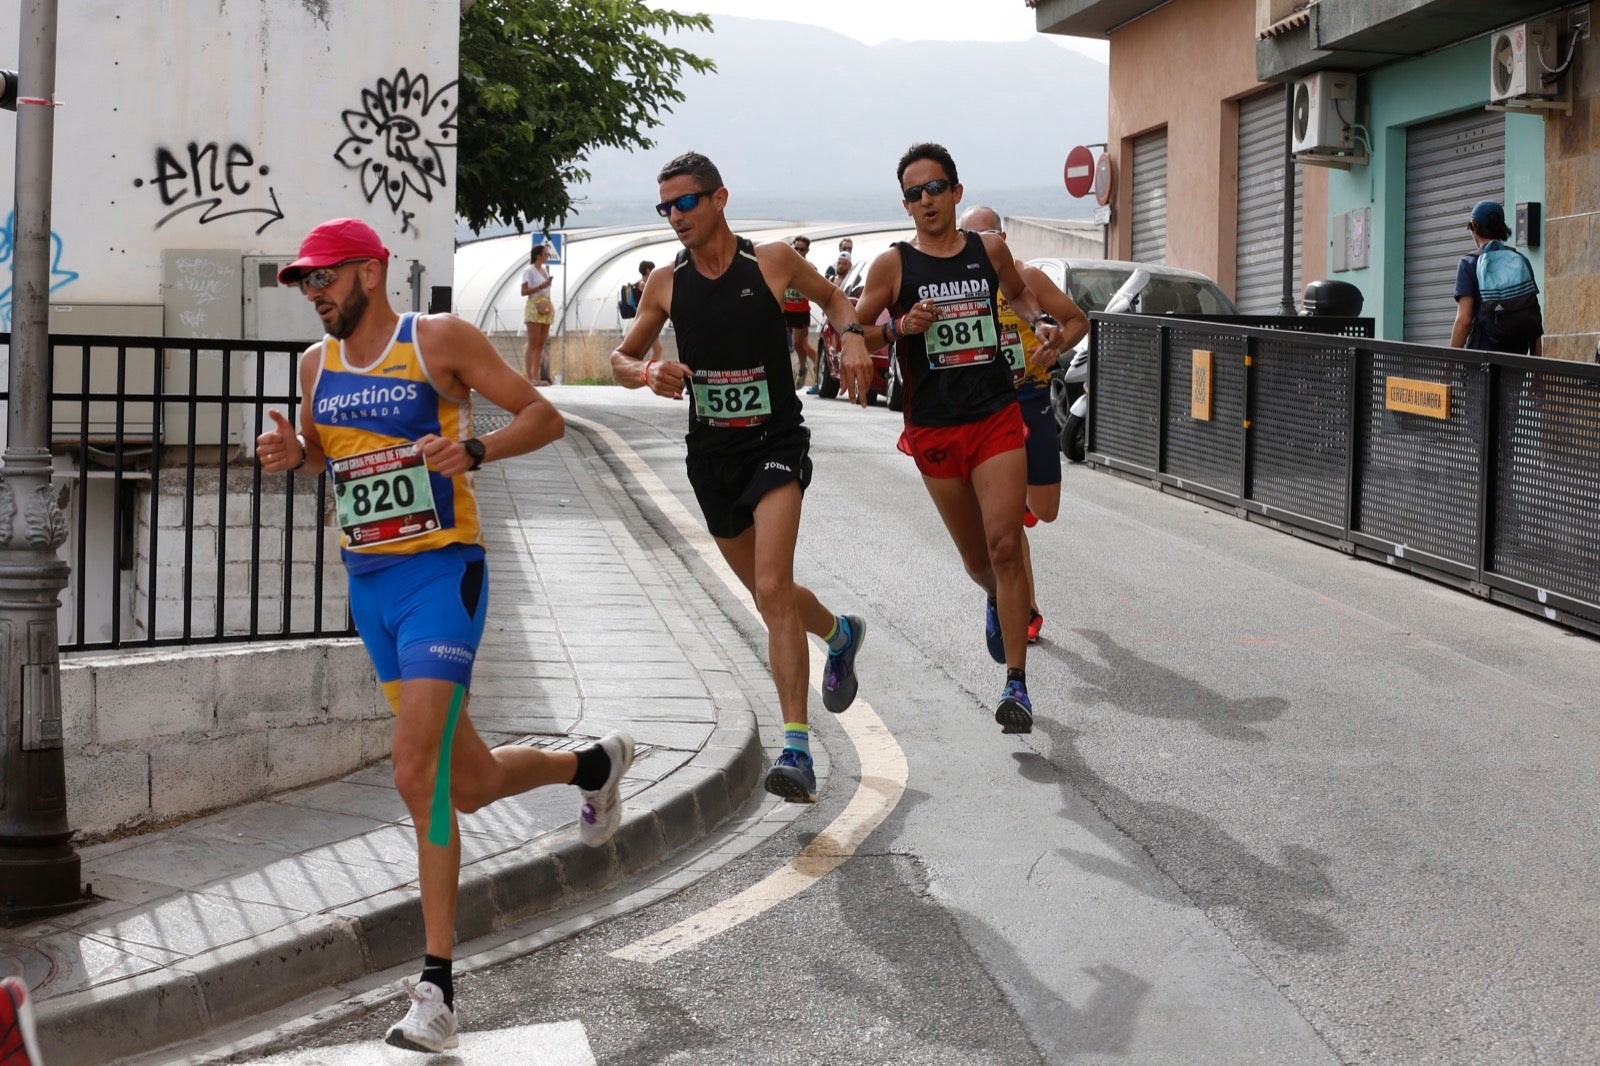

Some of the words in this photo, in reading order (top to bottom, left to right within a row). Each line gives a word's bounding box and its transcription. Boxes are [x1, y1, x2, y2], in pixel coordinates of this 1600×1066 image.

[918, 278, 989, 300] GRANADA
[937, 319, 984, 347] 981
[318, 384, 417, 415] agustinos
[708, 386, 762, 412] 582
[1391, 386, 1414, 404] CERVEZAS
[1414, 390, 1442, 409] ALHAMBRA
[331, 406, 400, 423] GRANADA
[352, 474, 415, 517] 820
